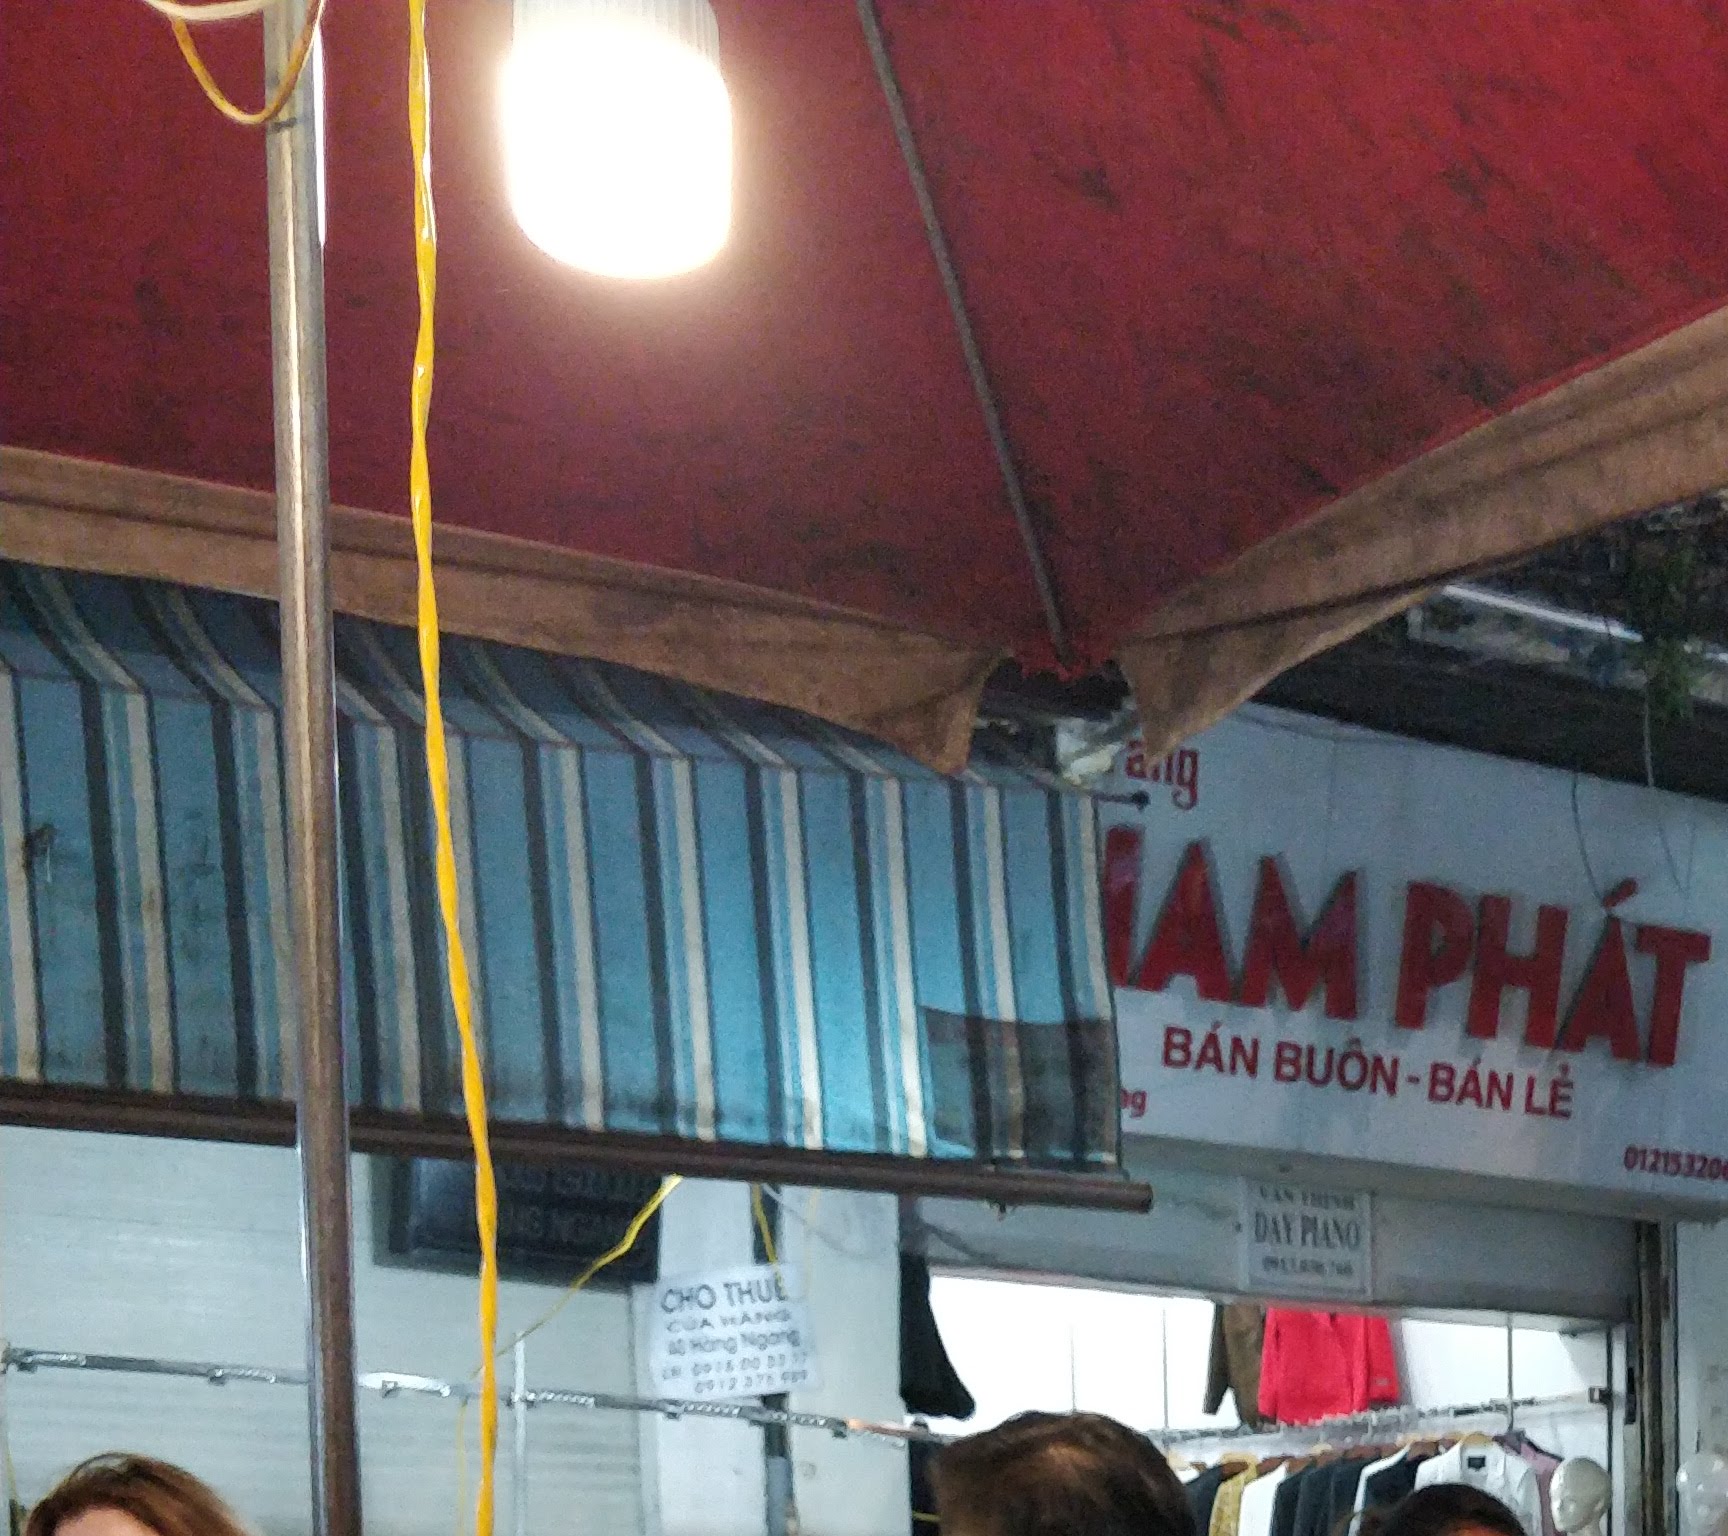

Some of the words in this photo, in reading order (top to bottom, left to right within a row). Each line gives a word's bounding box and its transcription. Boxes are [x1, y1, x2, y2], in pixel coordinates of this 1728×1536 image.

[1395, 878, 1712, 1067] PHÁT
[1161, 1020, 1260, 1078] BÁN
[1273, 1036, 1399, 1098] BUÔN
[1427, 1059, 1513, 1111] BÁN
[661, 1283, 717, 1314] CHO
